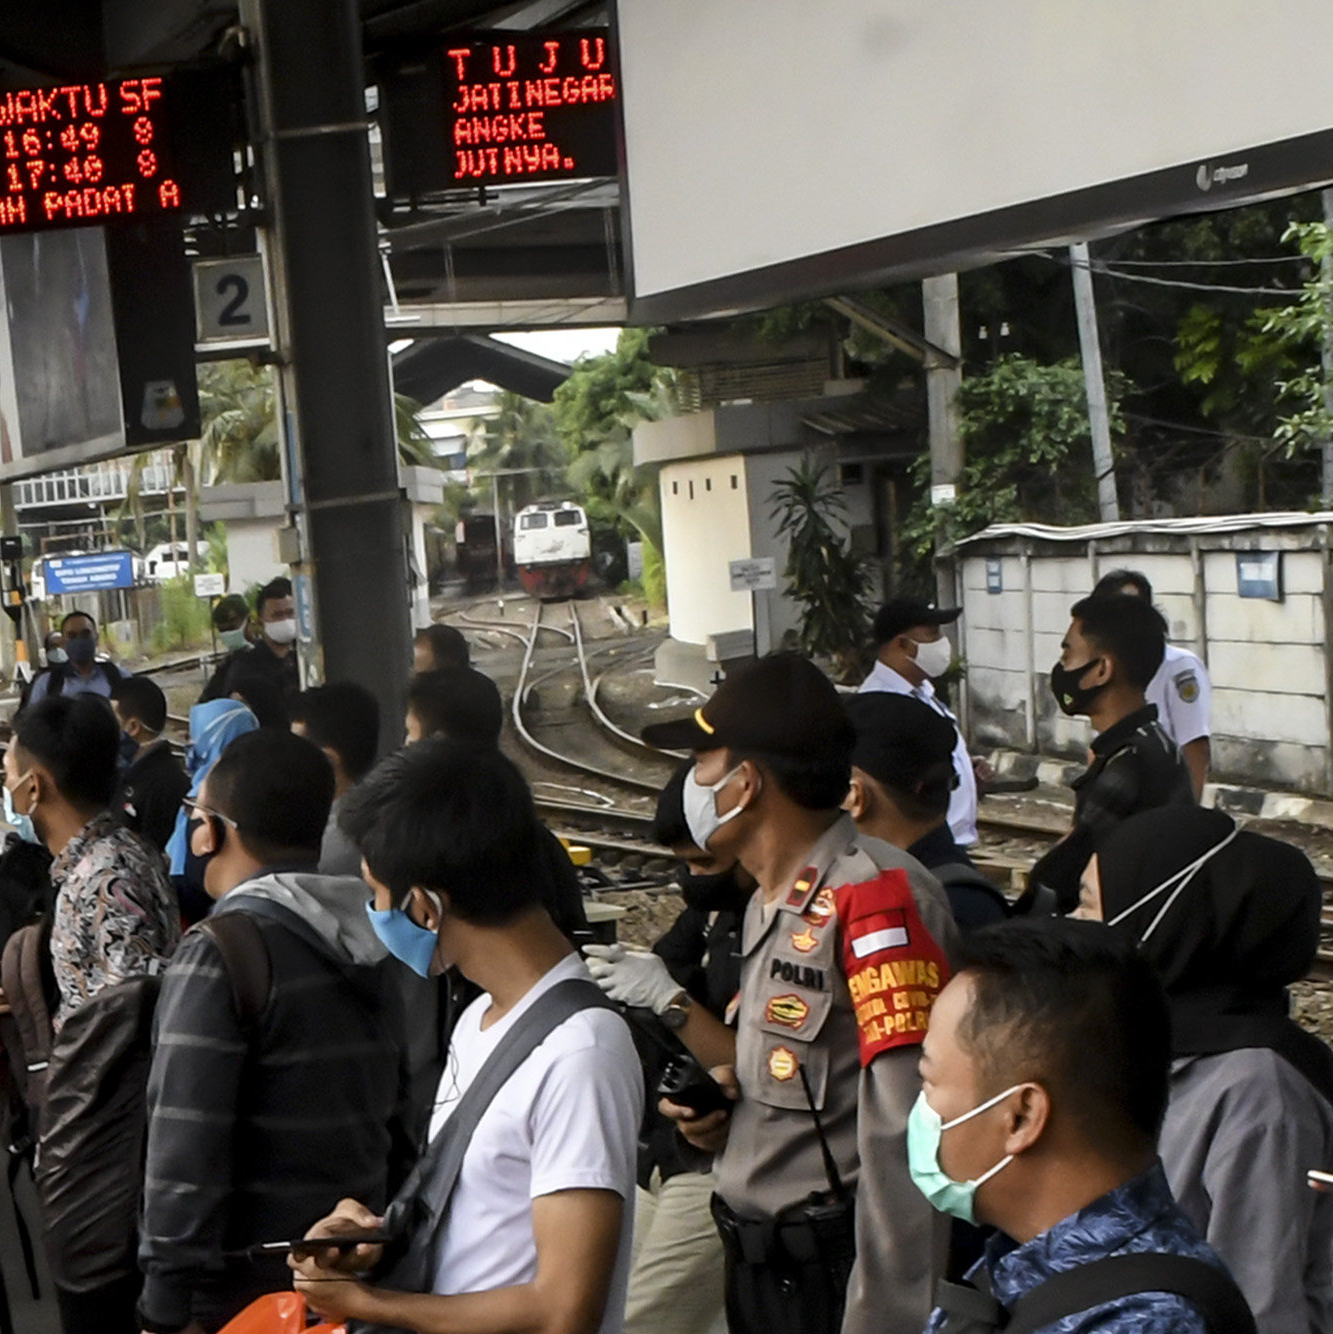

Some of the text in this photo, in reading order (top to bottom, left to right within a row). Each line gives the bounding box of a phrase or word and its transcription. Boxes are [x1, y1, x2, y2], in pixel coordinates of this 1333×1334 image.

[120, 77, 162, 115] SF
[4, 122, 99, 158] 16:49
[133, 116, 153, 144] 8
[454, 111, 546, 146] ANGKE
[137, 149, 157, 178] 8
[454, 143, 575, 178] JUTNYA.
[44, 183, 134, 220] PADAT
[160, 179, 180, 208] A
[216, 274, 251, 326] 2
[770, 958, 824, 991] POLRI
